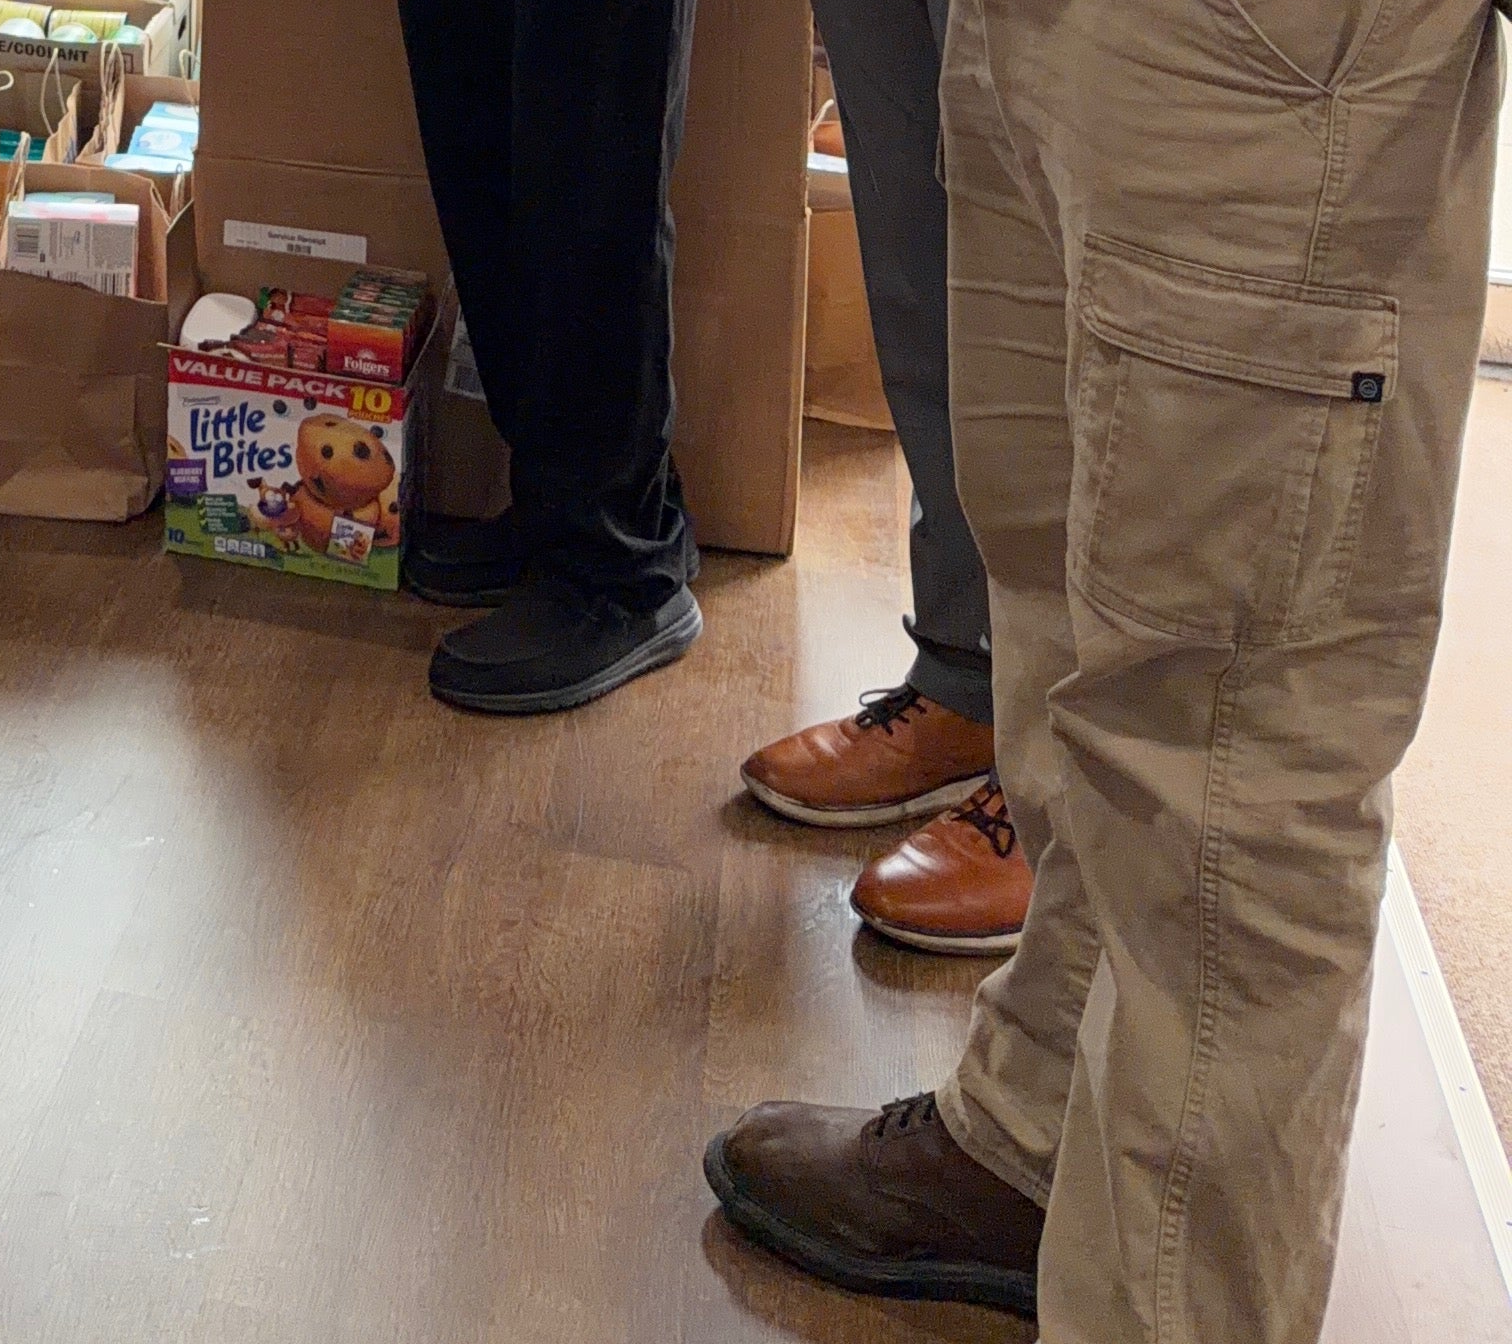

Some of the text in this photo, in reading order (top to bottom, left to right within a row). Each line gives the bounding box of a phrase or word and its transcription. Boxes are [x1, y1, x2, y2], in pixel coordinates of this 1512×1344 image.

[344, 357, 390, 375] Folgers
[173, 358, 392, 413] VALUE PACK 10
[190, 402, 266, 452] Little
[213, 441, 293, 479] Bites
[169, 528, 184, 543] 10
